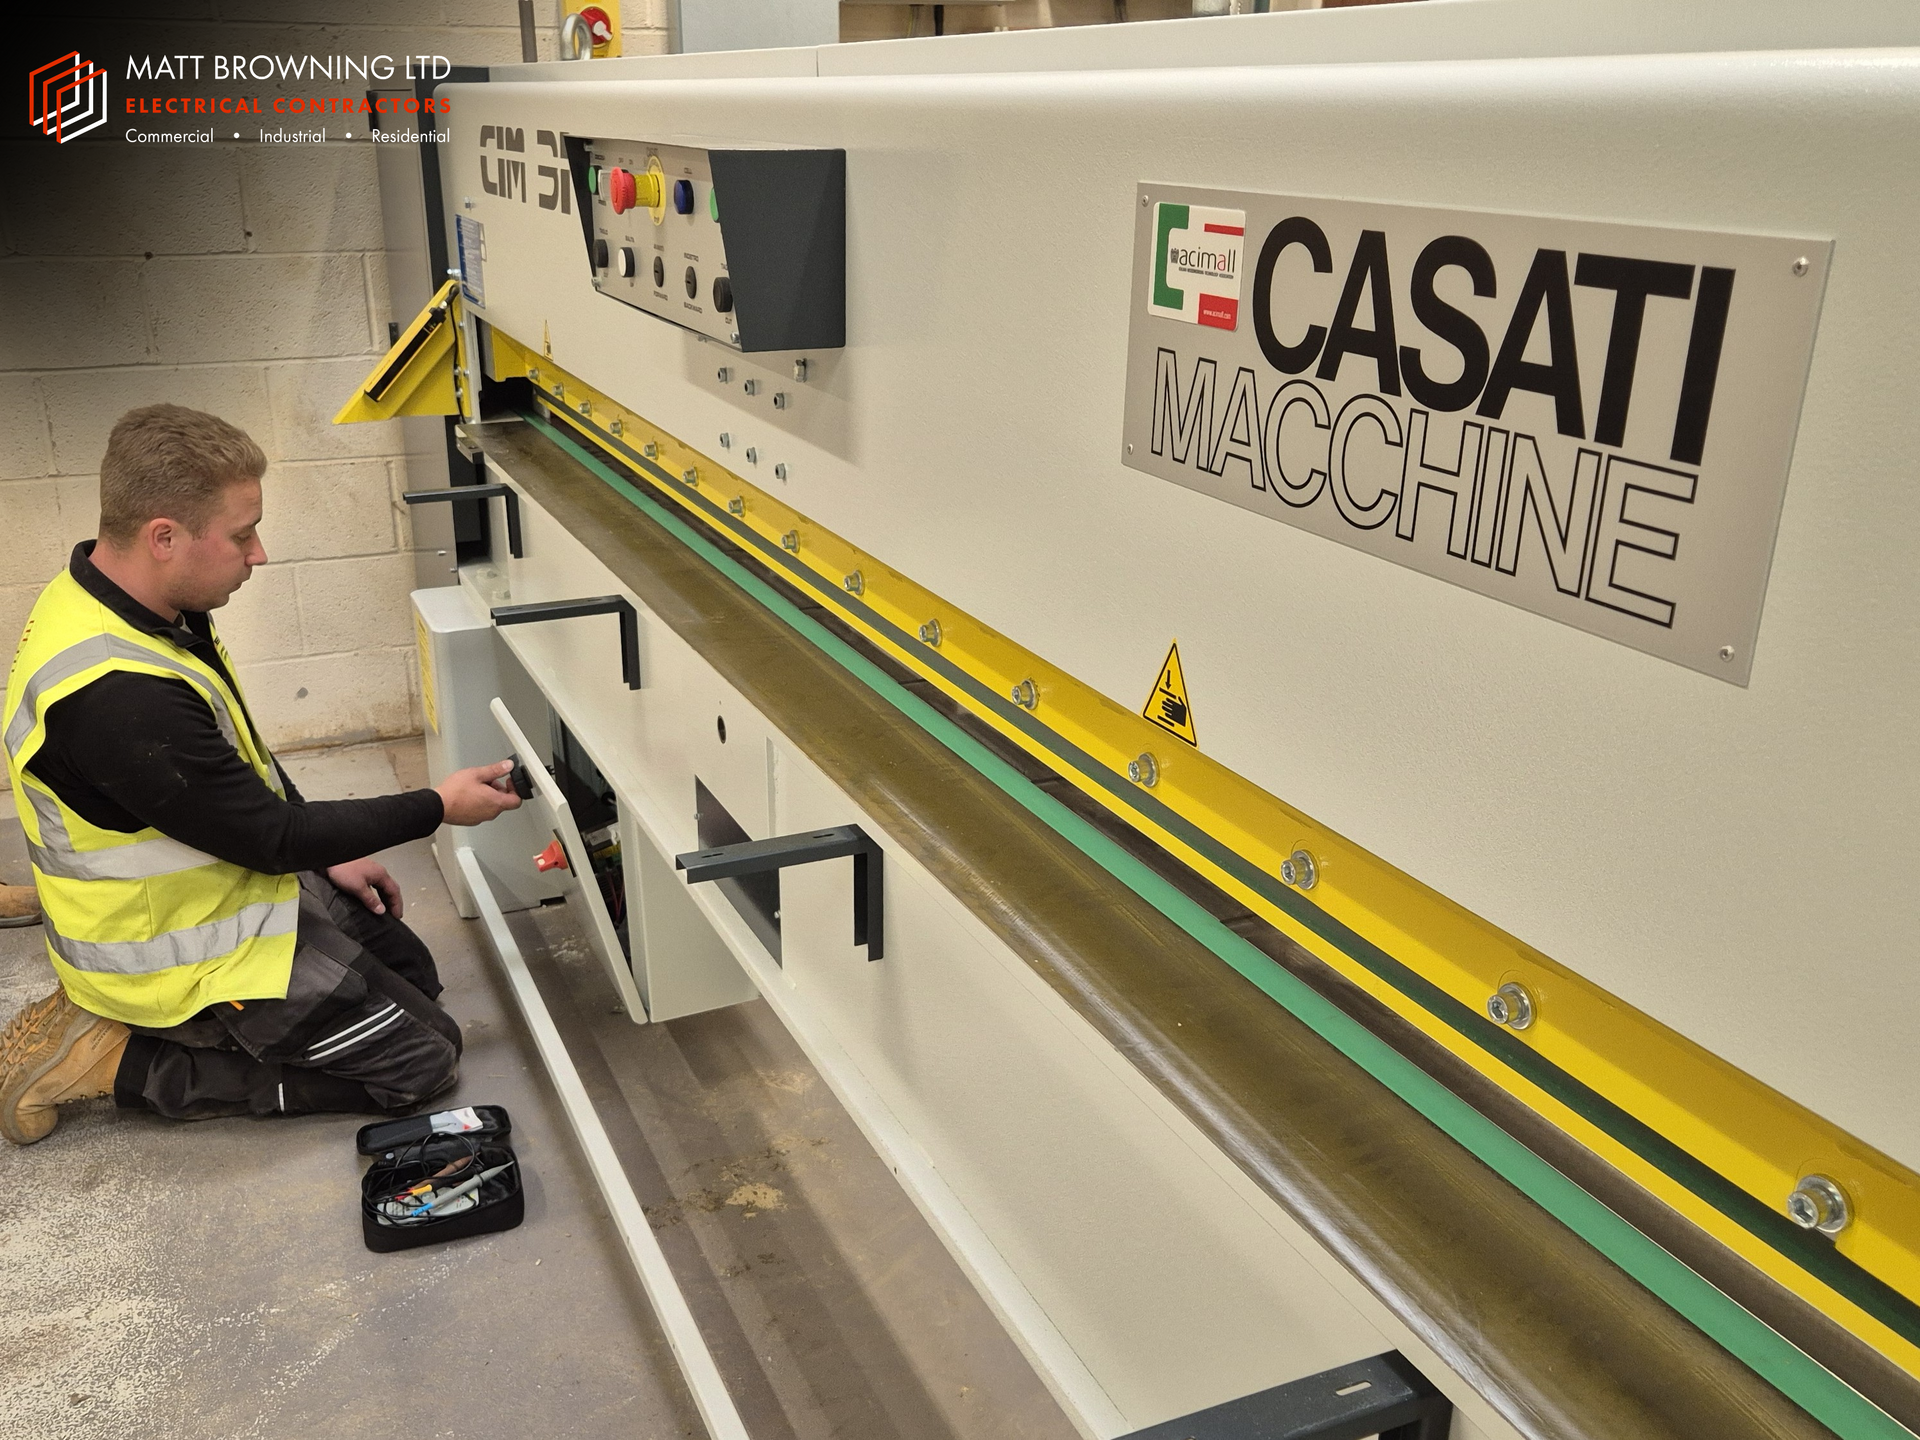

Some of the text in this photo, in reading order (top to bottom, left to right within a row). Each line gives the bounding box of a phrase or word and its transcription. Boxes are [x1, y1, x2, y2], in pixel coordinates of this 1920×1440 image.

[479, 125, 527, 204] CIM
[1179, 247, 1236, 273] acimall
[1253, 217, 1735, 466] CASATI
[1151, 347, 1699, 629] MACCHINE
